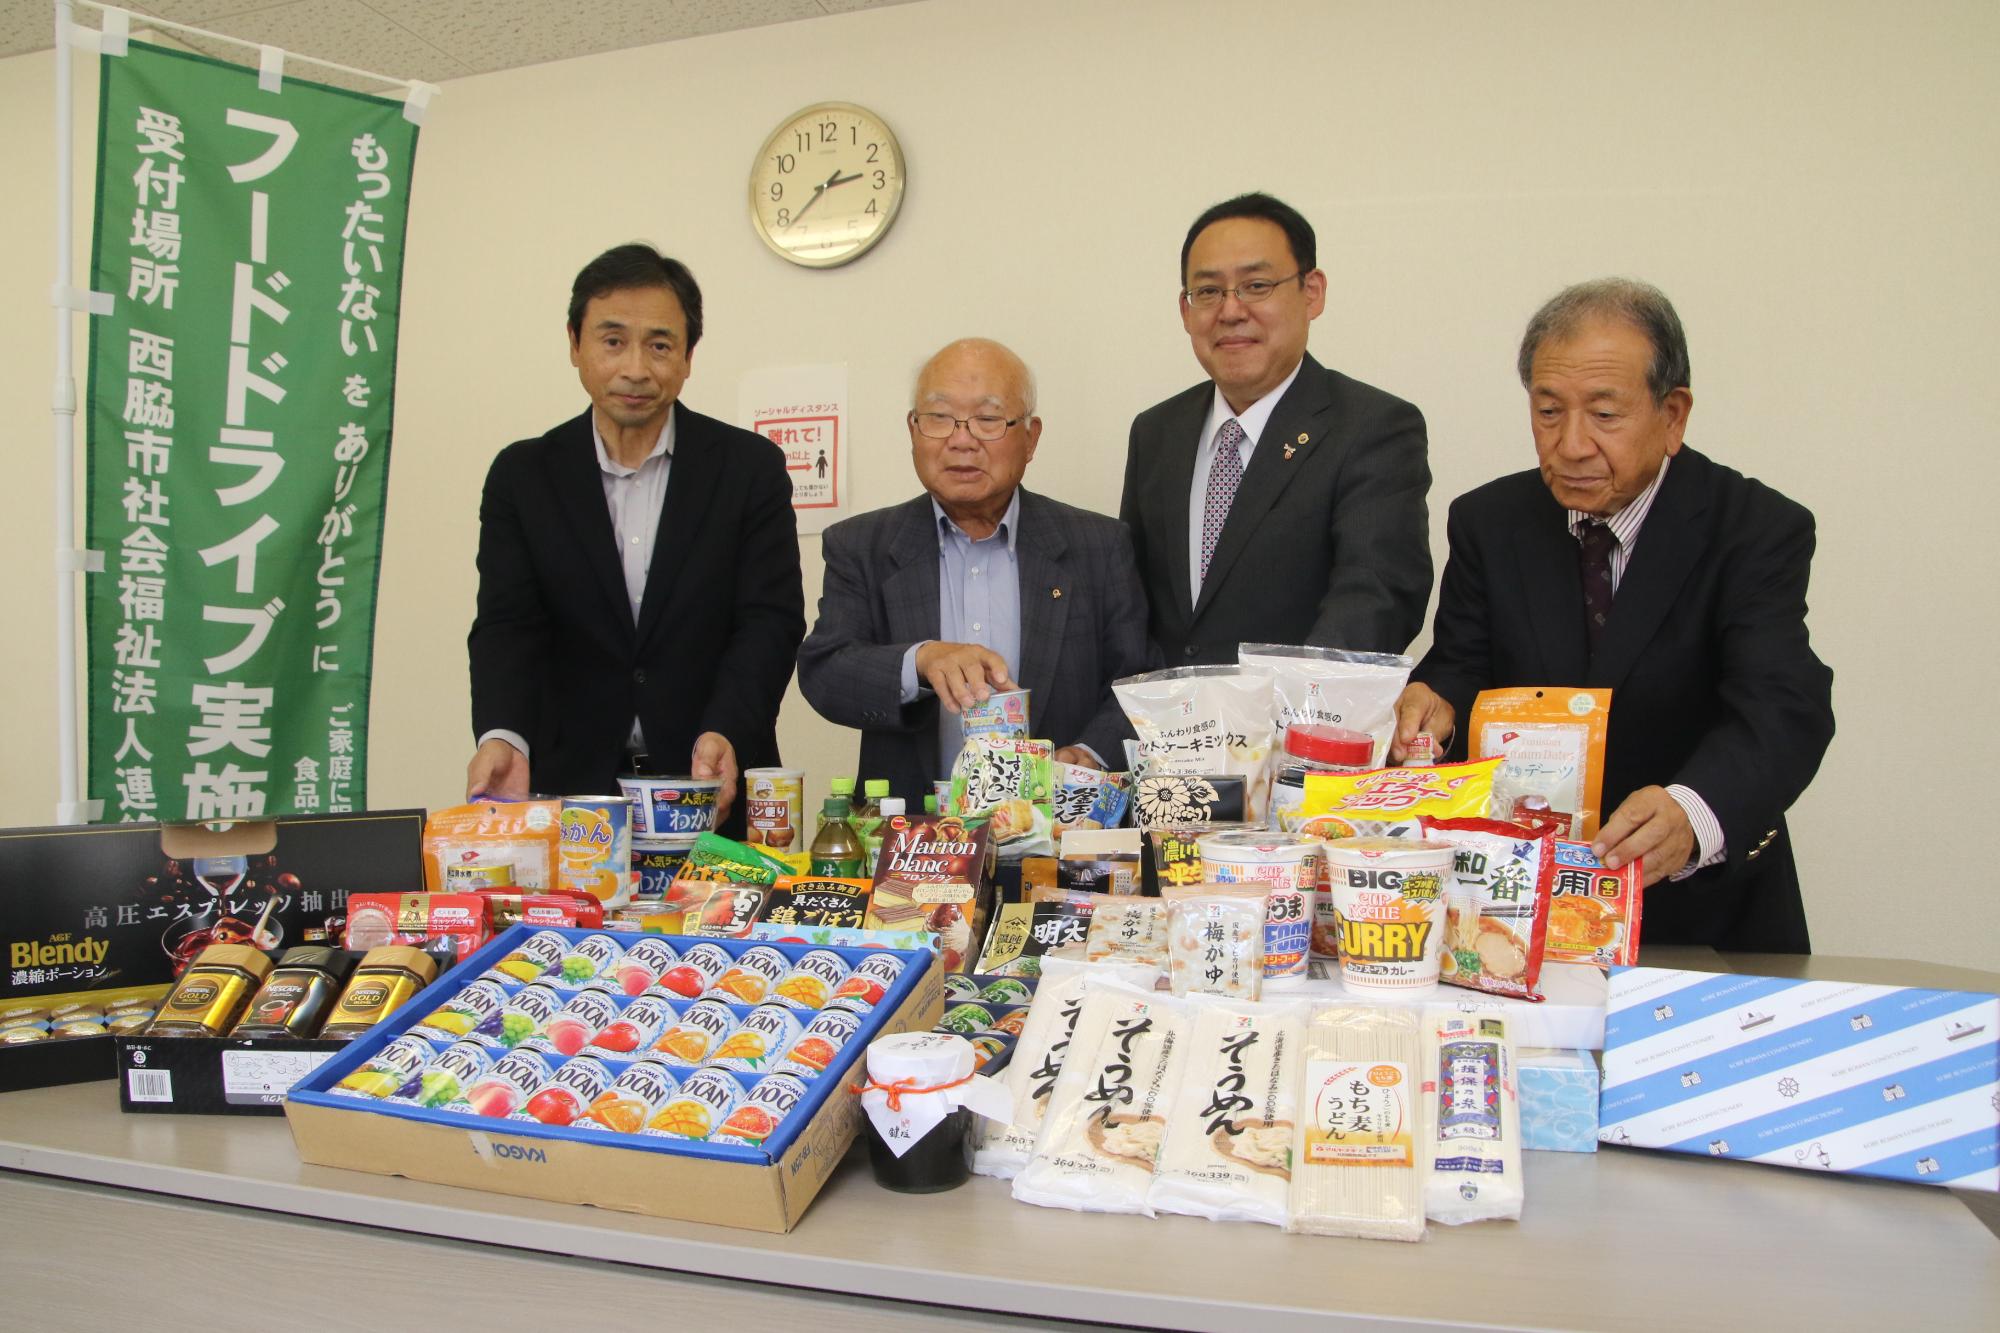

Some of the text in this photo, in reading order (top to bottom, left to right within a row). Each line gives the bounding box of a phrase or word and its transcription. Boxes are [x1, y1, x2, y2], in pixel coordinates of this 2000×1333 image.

[796, 132, 810, 152] 11
[819, 122, 837, 143] 12
[850, 126, 856, 145] 1
[866, 143, 878, 163] 2
[777, 154, 795, 174] 10
[872, 170, 885, 189] 3
[771, 182, 783, 201] 9
[864, 198, 878, 217] 4
[777, 208, 790, 228] 8
[313, 133, 391, 673] もったいない を ありがとう に
[112, 106, 186, 823] 受付場所 西脇市社会福祉法人連
[889, 833, 977, 856] Marron
[822, 864, 835, 877] 生
[888, 852, 950, 873] blanc
[901, 873, 955, 882] マロンブラン
[1348, 869, 1403, 890] BIG
[83, 887, 349, 929] 高圧エスプレッソ抽出
[792, 894, 852, 908] 具だくさん
[1356, 893, 1391, 907] CUP
[766, 905, 864, 928] 鶏ごぼう
[49, 932, 72, 943] AGF
[1334, 908, 1433, 962] CURRY
[11, 937, 109, 968] Blendy
[1204, 921, 1225, 985] 梅がゆ
[11, 965, 107, 986] 濃縮ポーション
[1390, 966, 1416, 976] カレー
[179, 992, 210, 1000] GOLD
[349, 994, 381, 1002] GOLD
[1085, 1018, 1153, 1129] そうめん
[1199, 1031, 1260, 1136] そうめん
[1347, 1080, 1373, 1133] もち麦
[1326, 1096, 1347, 1140] うどん
